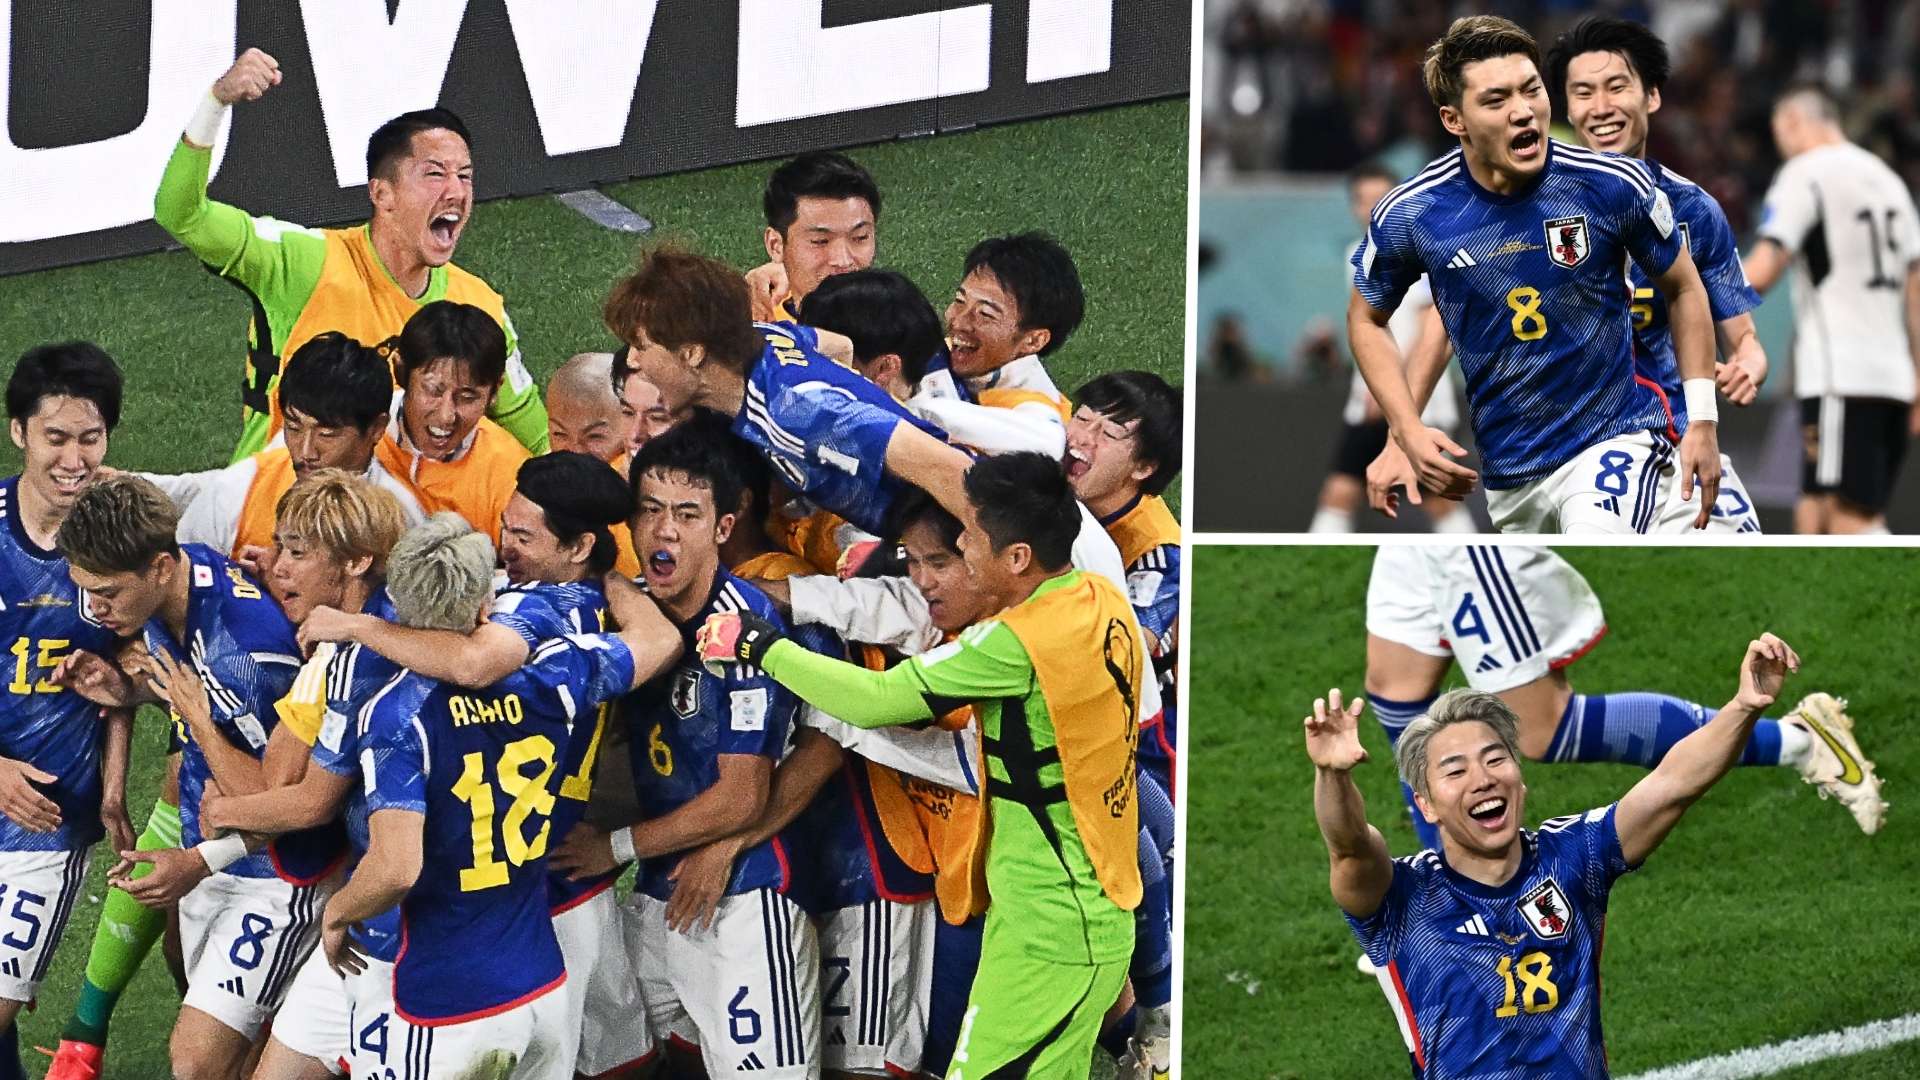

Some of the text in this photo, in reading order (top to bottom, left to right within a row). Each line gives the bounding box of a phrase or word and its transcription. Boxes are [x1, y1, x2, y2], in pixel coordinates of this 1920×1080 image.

[1506, 287, 1548, 341] 8
[1595, 449, 1634, 497] 8
[1452, 592, 1492, 645] 4
[10, 636, 70, 694] 15
[649, 723, 674, 777] 6
[451, 734, 557, 892] 18
[1525, 885, 1546, 902] JAPAN
[229, 912, 274, 970] 8
[1495, 951, 1558, 1018] 18
[728, 985, 761, 1044] 6
